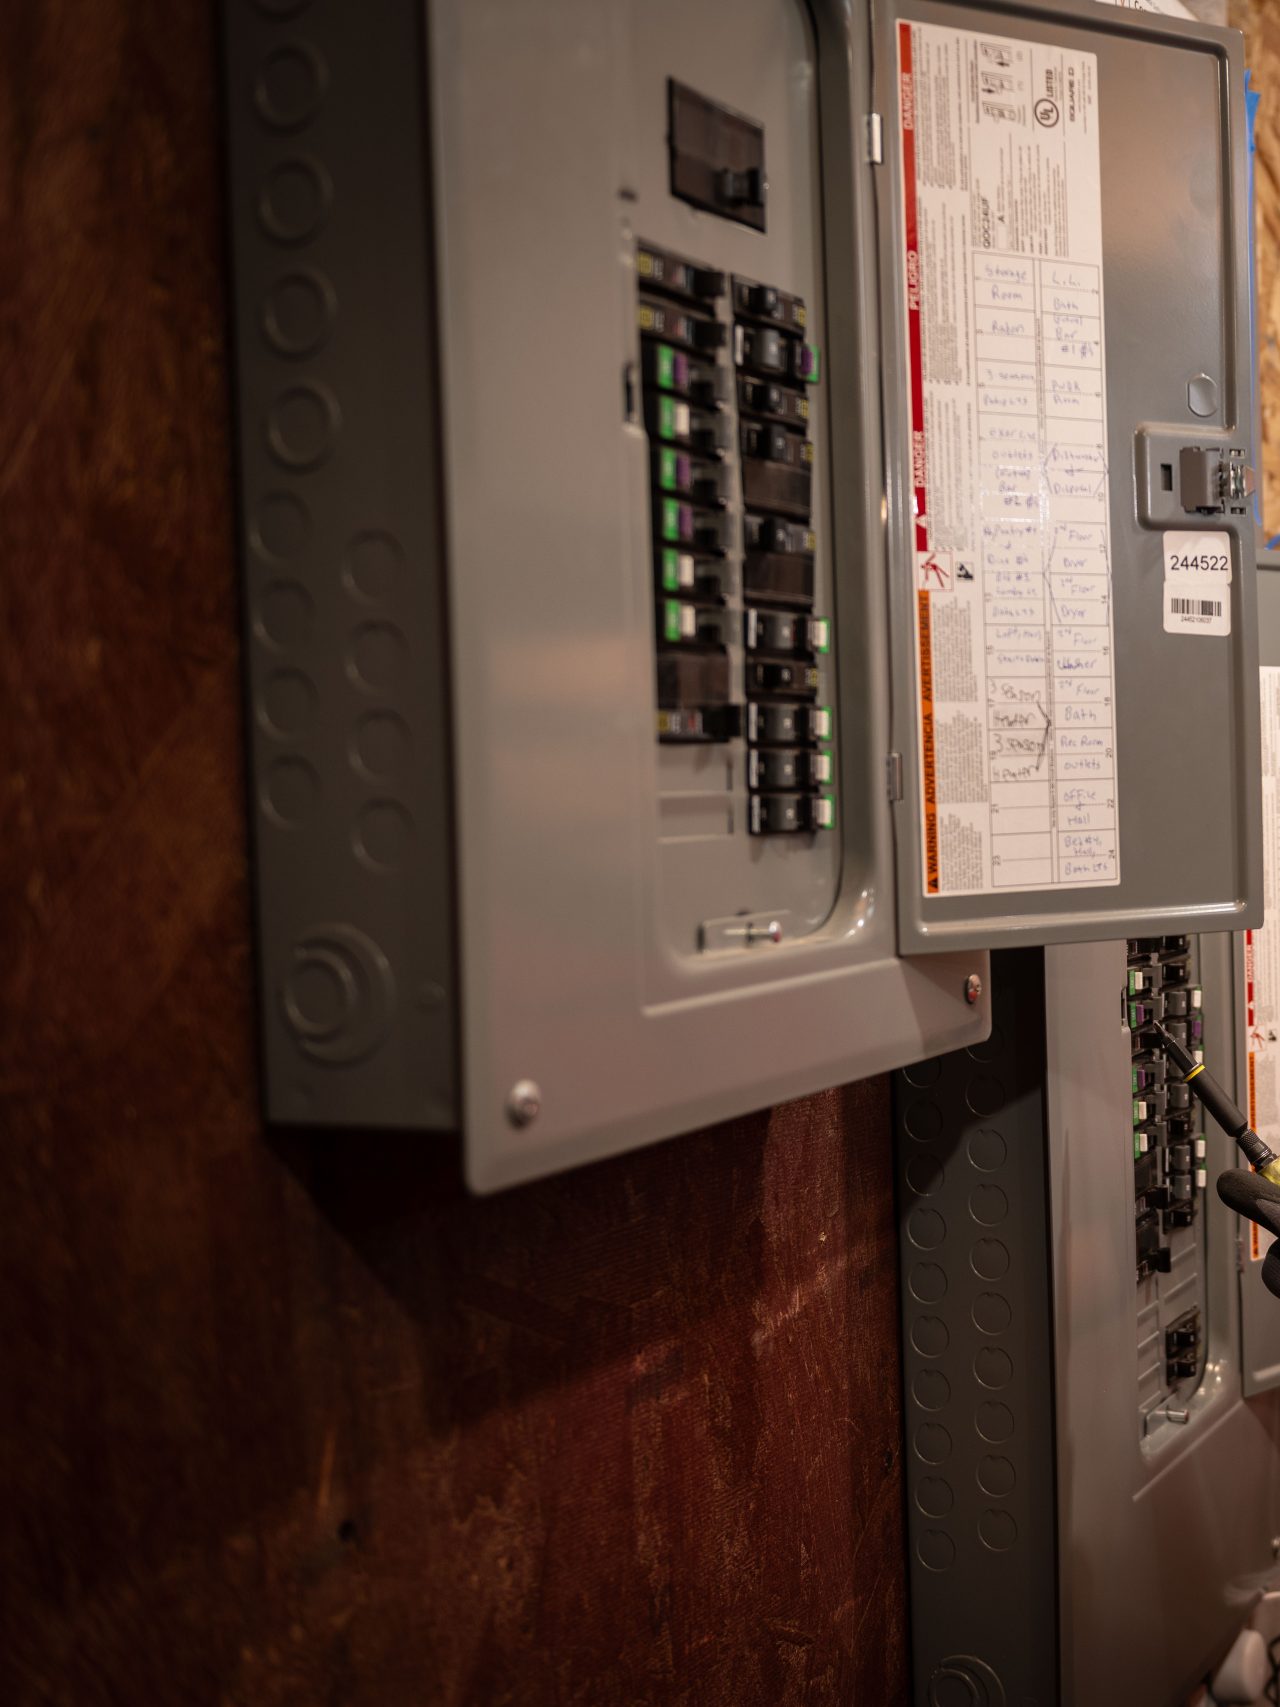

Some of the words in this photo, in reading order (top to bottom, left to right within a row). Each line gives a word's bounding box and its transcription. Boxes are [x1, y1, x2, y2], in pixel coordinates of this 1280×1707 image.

[902, 72, 914, 130] DANGER
[907, 250, 920, 310] PELIGRO
[913, 431, 925, 488] DANGER
[1170, 555, 1229, 571] 244522
[923, 714, 937, 803] ADVERTENCIA
[926, 812, 938, 874] WARNING
